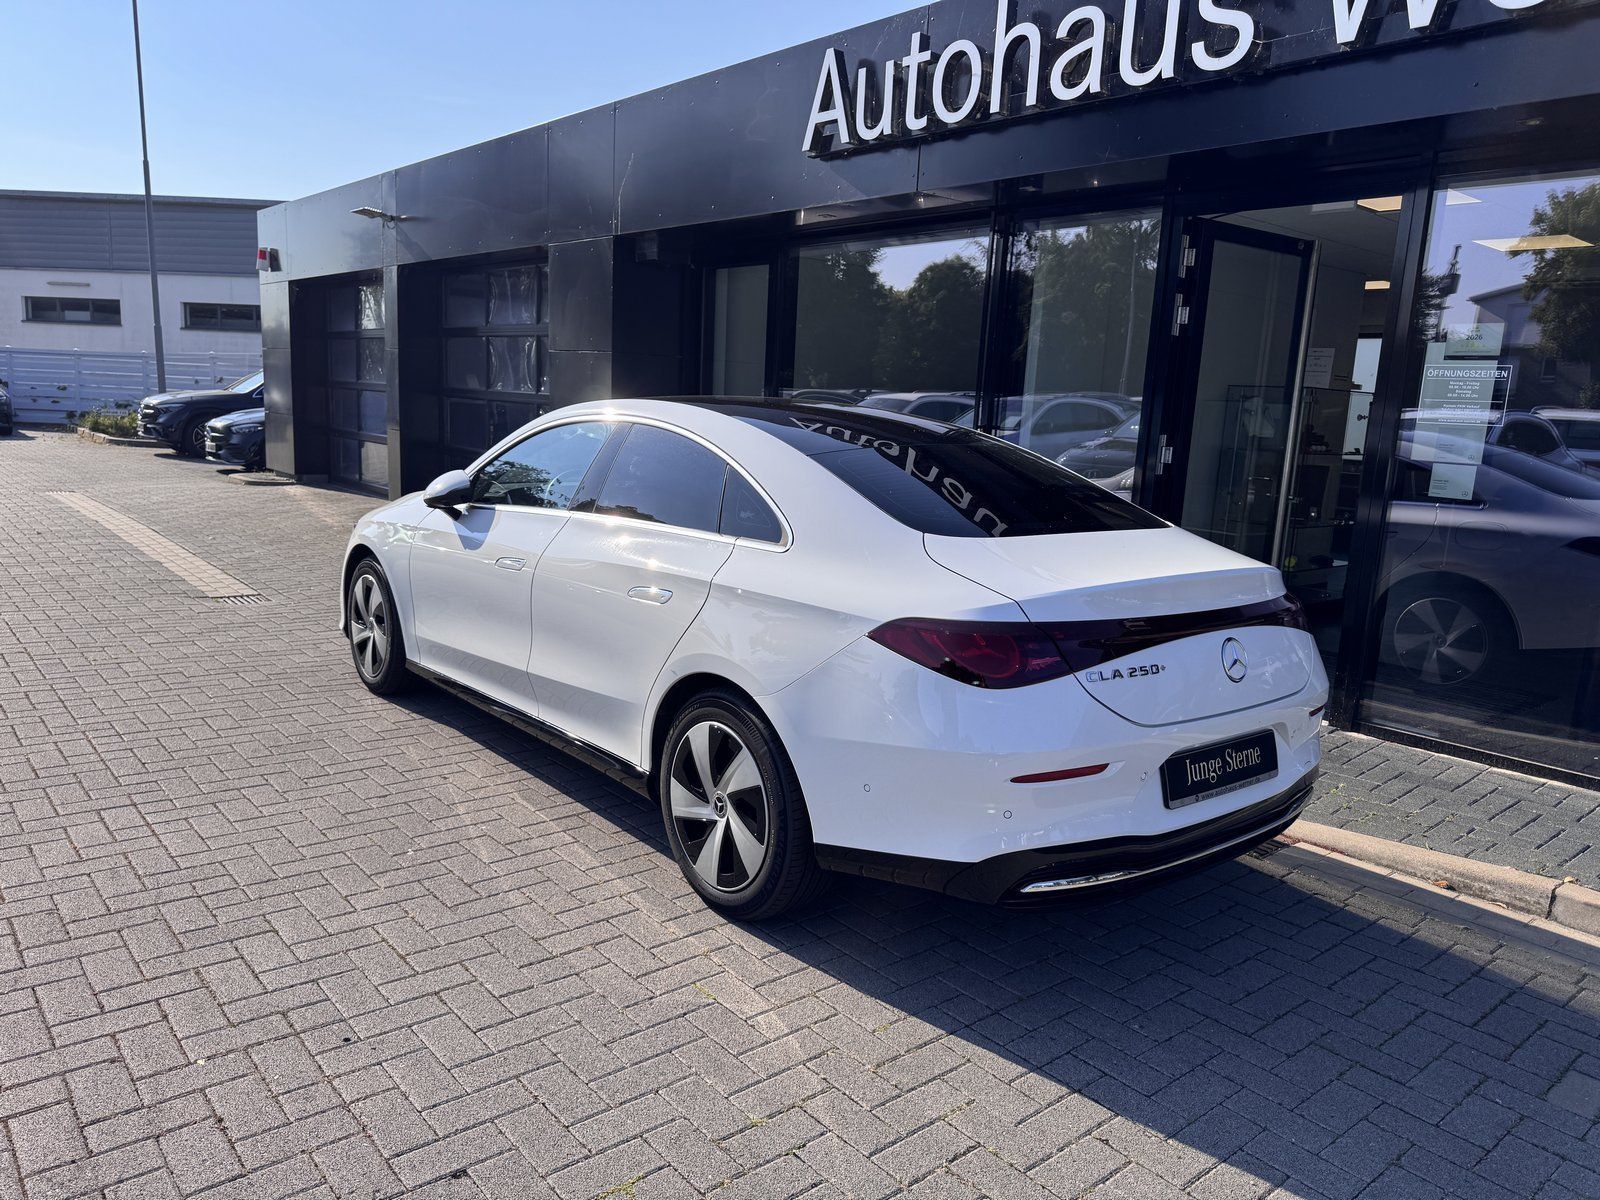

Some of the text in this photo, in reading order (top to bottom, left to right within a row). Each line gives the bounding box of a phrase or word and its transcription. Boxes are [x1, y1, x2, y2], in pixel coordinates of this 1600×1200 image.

[801, 0, 1255, 153] Autohaus
[1427, 368, 1508, 378] ÖFFNUNGSZEITEN
[1086, 668, 1124, 682] CLA
[1185, 746, 1261, 786] Junge Sterne
